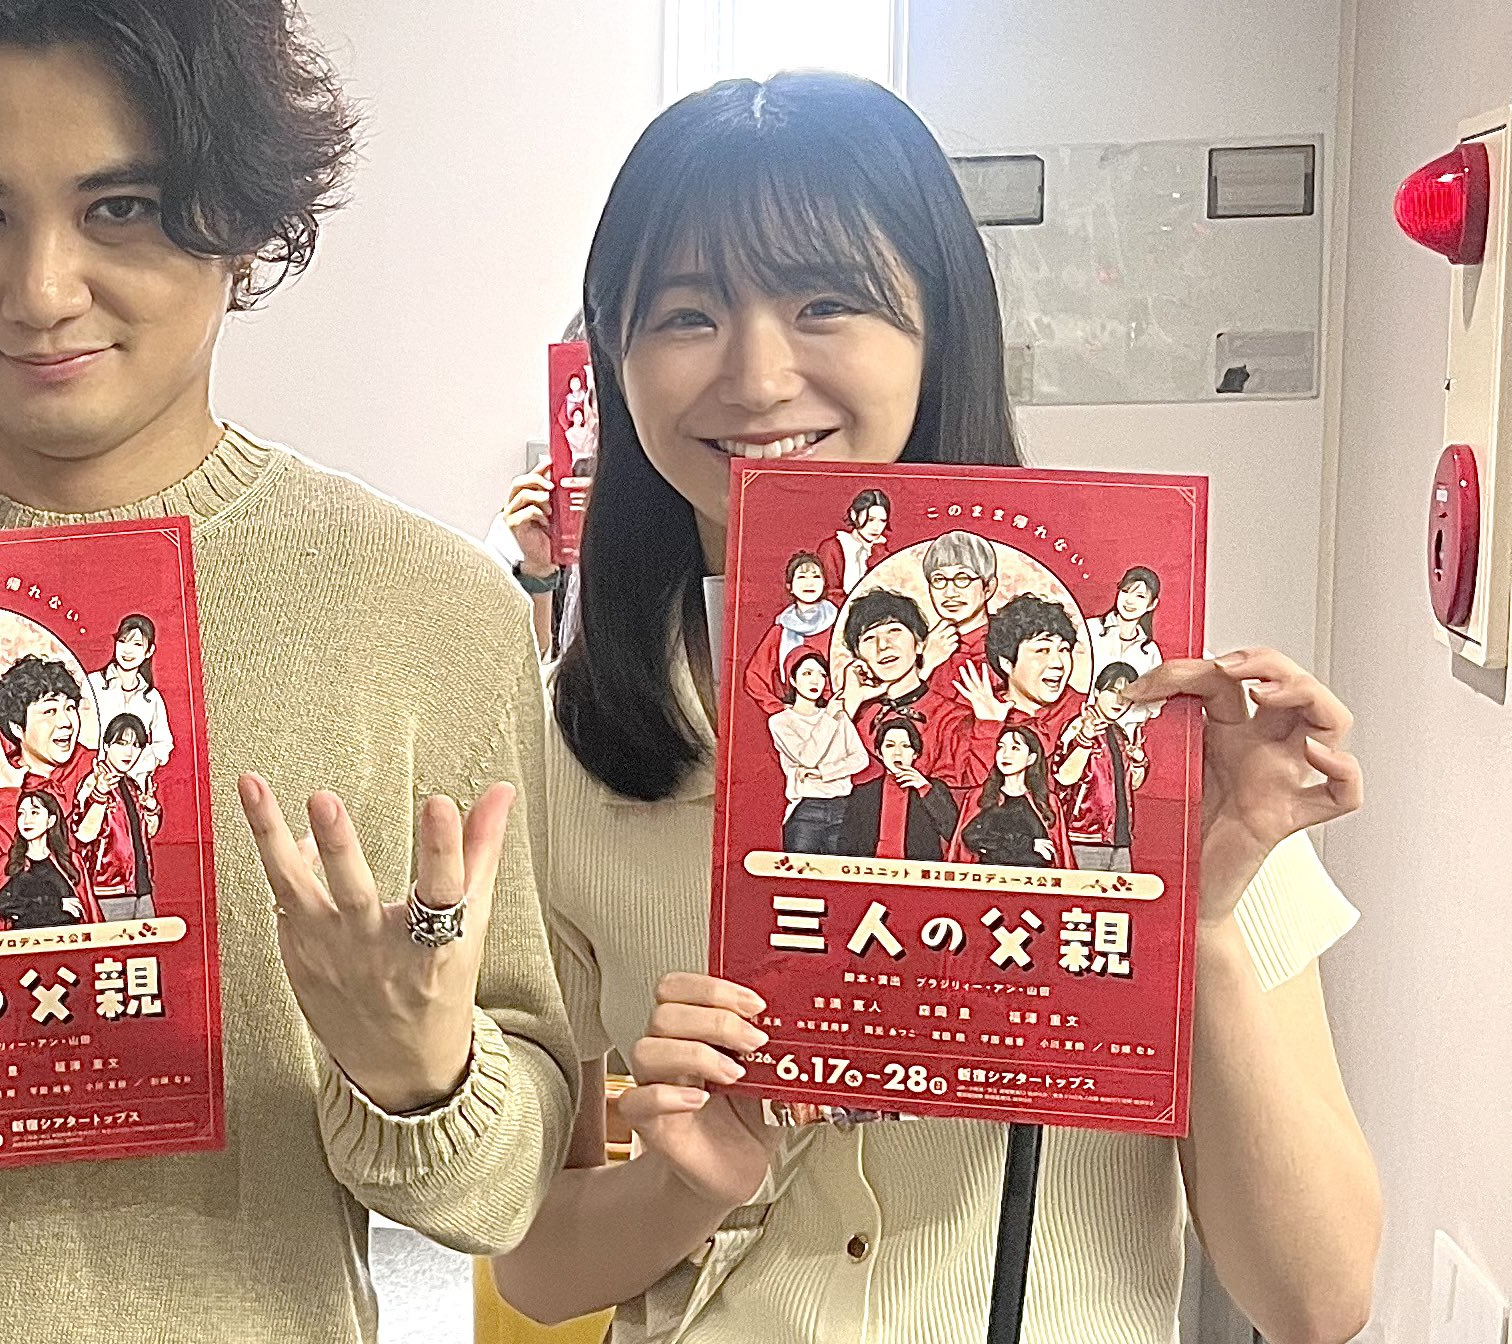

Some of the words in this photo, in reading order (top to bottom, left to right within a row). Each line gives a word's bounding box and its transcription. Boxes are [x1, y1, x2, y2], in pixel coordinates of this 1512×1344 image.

[769, 895, 1131, 976] 三人の父親
